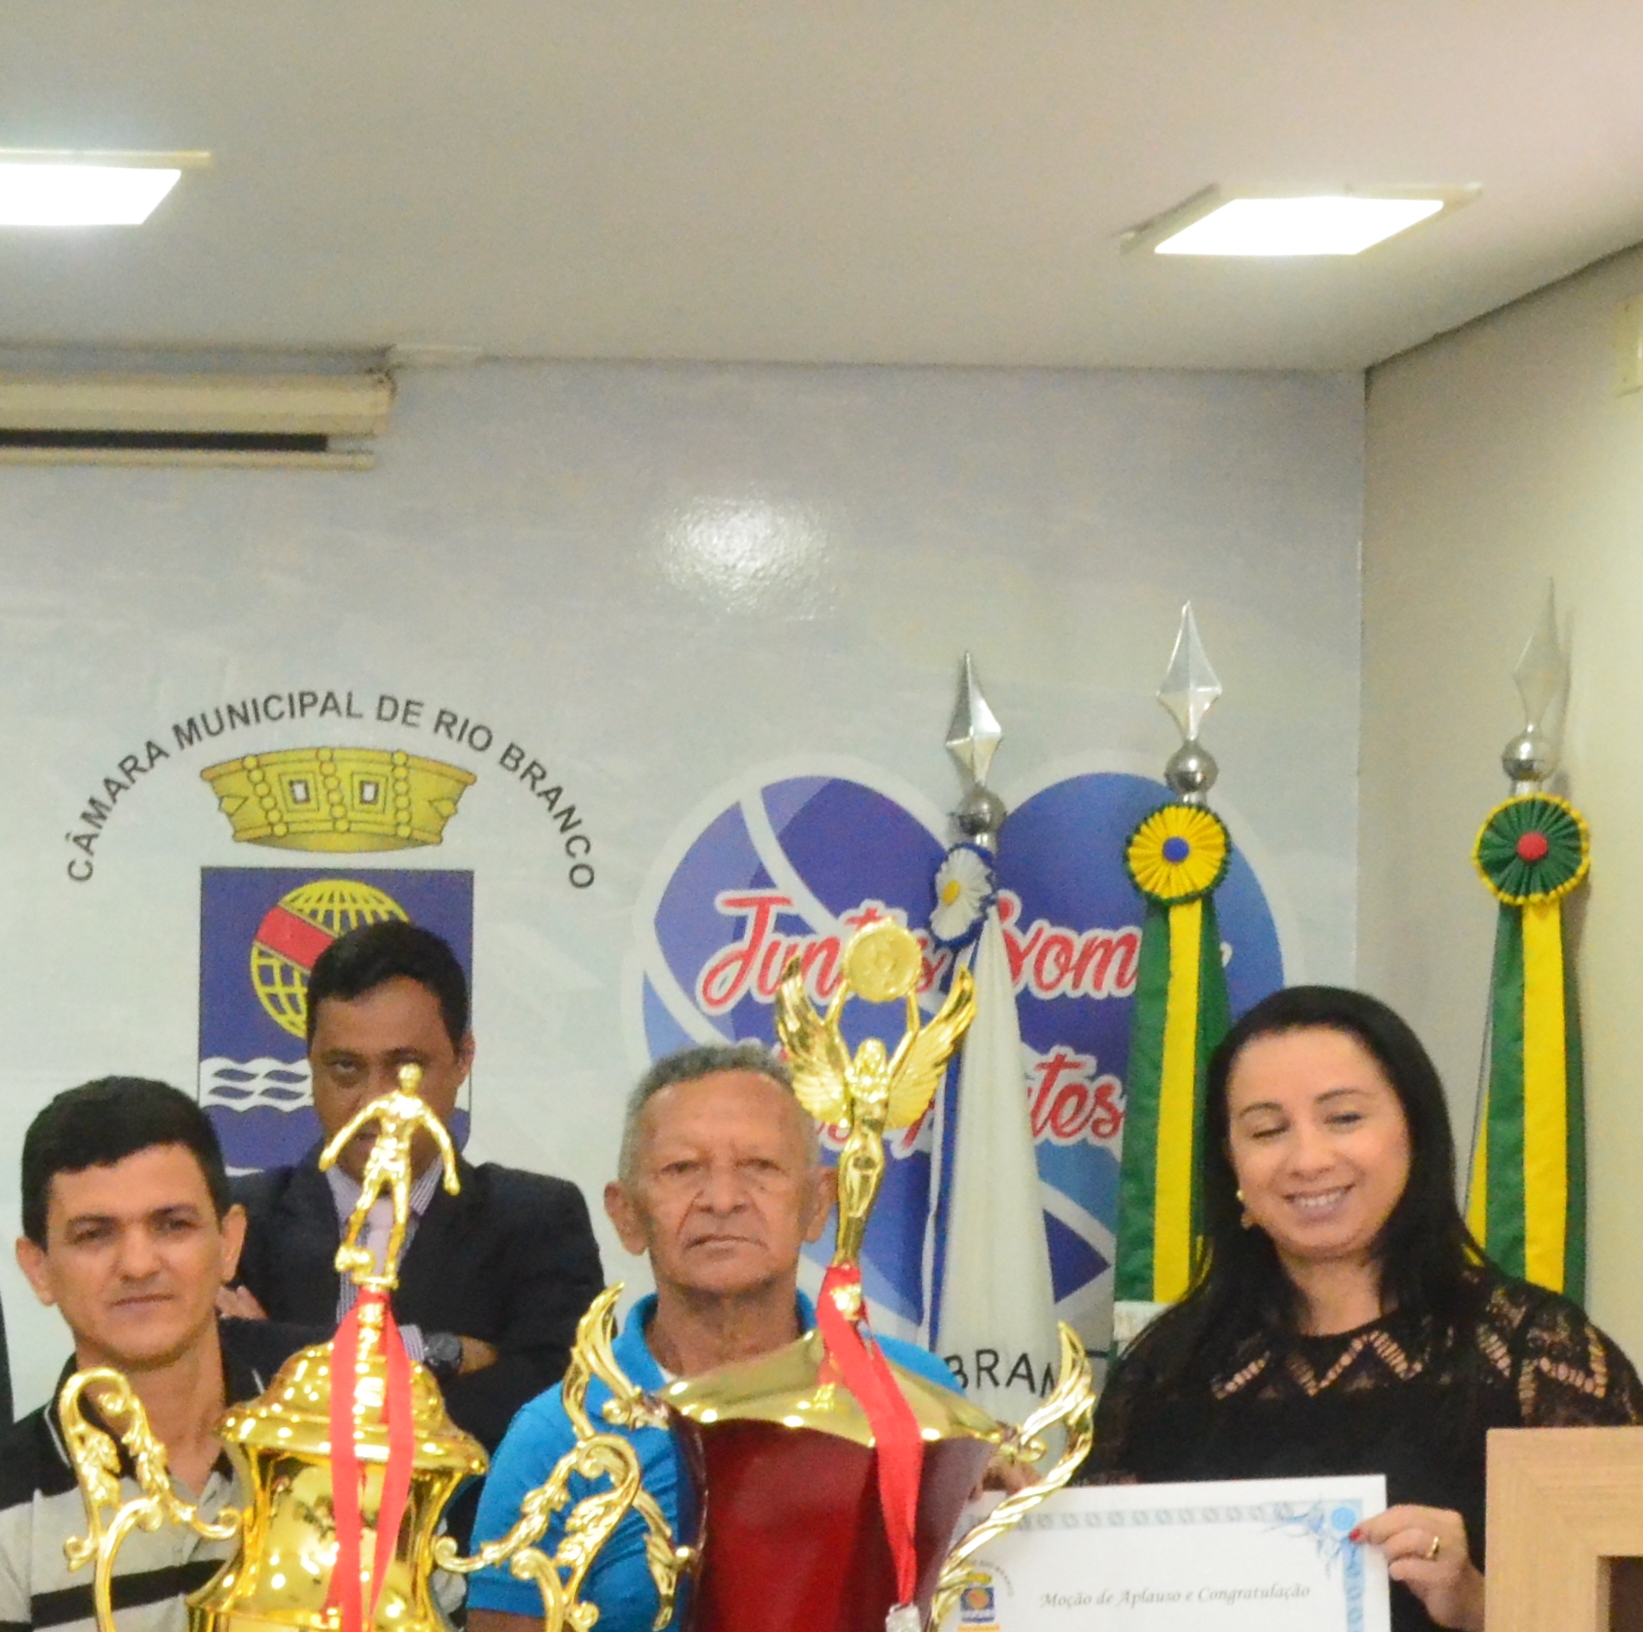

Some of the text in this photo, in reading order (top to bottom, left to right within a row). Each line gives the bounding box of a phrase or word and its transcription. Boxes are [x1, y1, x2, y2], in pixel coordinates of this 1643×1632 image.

[66, 691, 596, 890] CÂMARA MUNICIPAL DE RIO BRANCO
[1040, 1582, 1310, 1609] Moção de Aplauso e Congratulação
